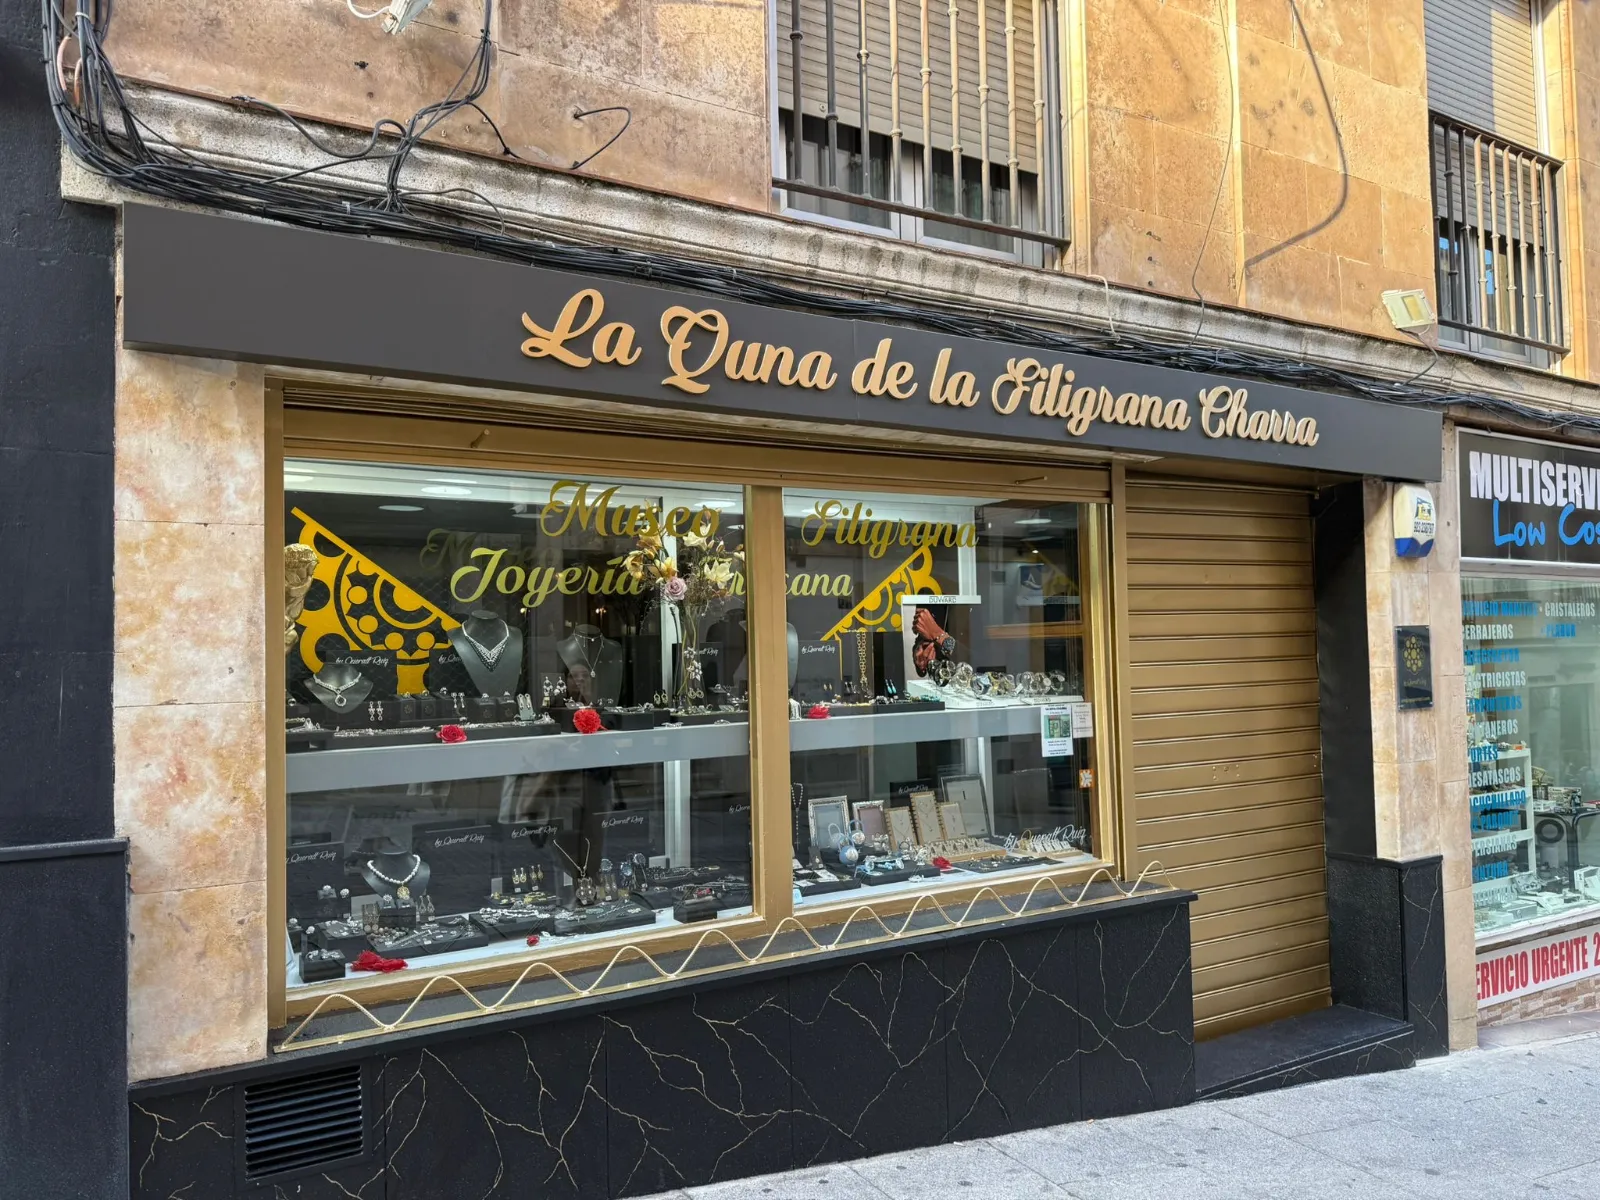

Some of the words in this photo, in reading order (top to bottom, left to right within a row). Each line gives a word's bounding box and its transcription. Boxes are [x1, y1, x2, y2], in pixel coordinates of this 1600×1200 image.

[521, 288, 642, 369] La
[850, 337, 919, 400] de
[929, 347, 980, 408] la
[991, 357, 1191, 437] Filigrana
[1199, 385, 1320, 447] Charra
[540, 479, 721, 538] Museo
[801, 499, 979, 560] Filigrana
[450, 546, 645, 608] Joyería
[1544, 601, 1596, 617] CRISTALEROS
[1531, 935, 1589, 985] URGENTE
